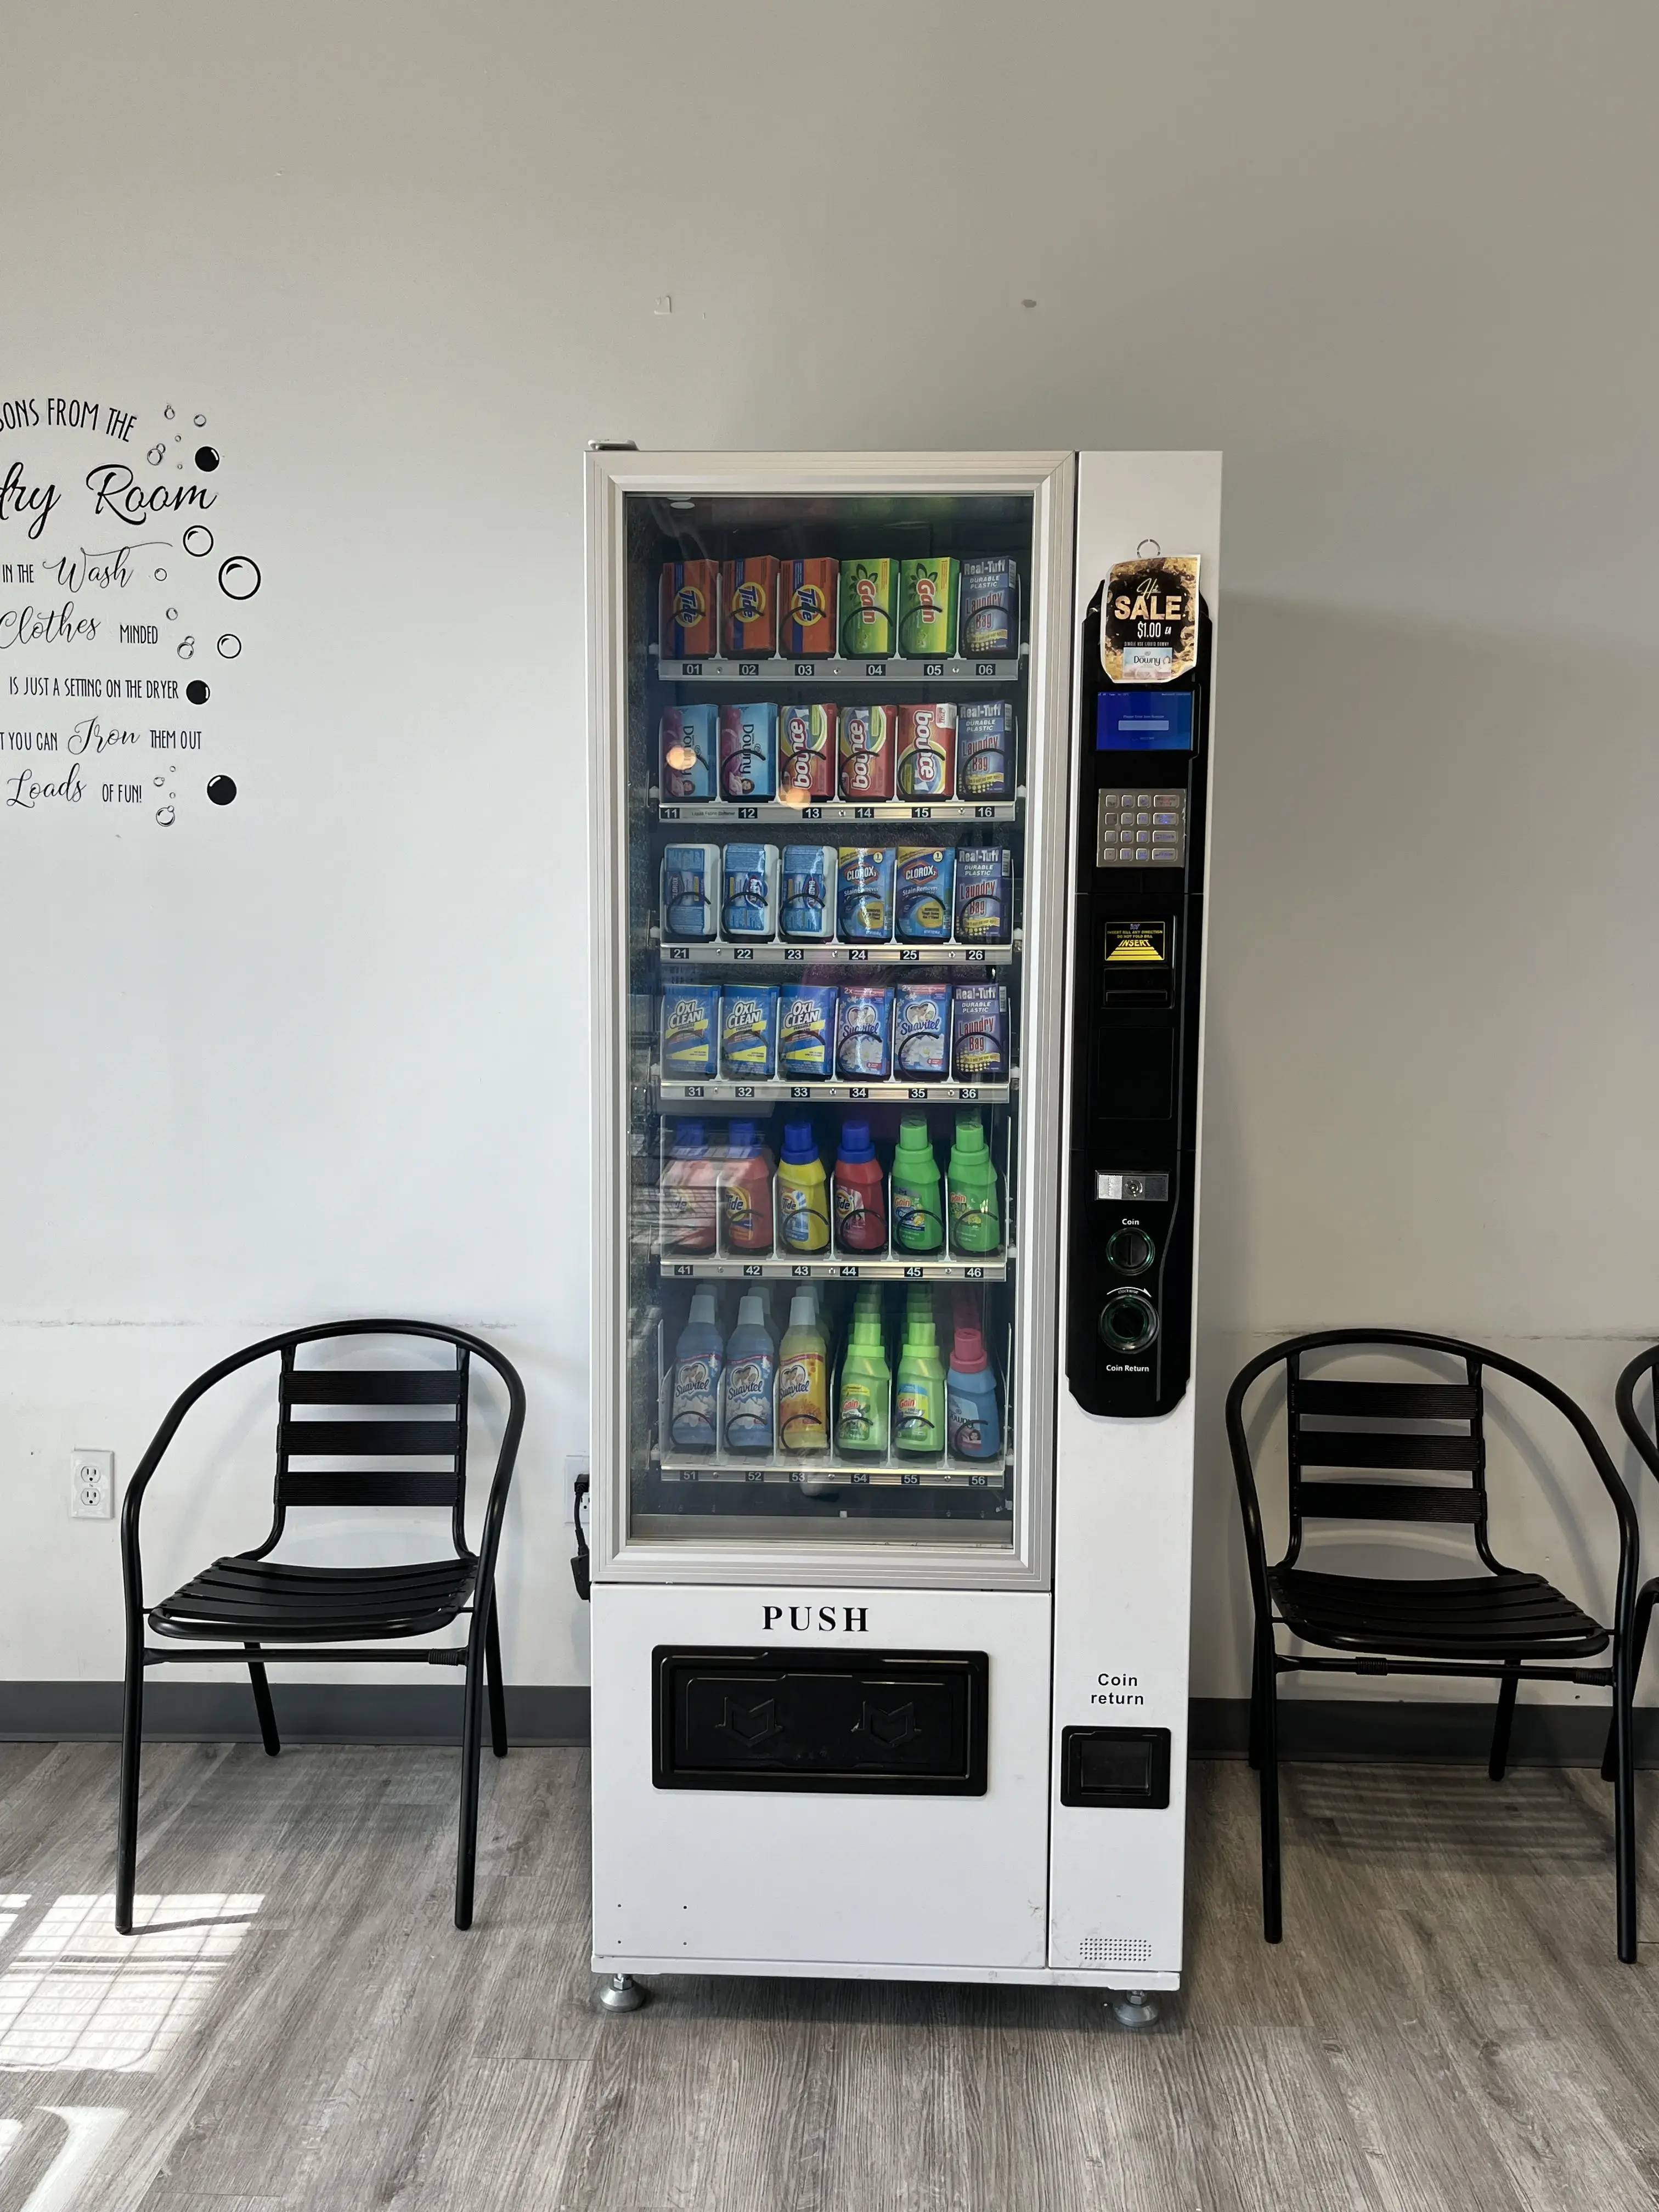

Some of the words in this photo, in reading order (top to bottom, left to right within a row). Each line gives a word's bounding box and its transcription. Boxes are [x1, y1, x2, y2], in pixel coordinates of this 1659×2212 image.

[47, 398, 99, 430] FROM
[106, 408, 137, 442] THE
[86, 464, 218, 525] Room
[2, 564, 13, 583] IN
[17, 564, 34, 583] THE
[43, 542, 173, 592] Wash
[738, 586, 757, 618] Tide
[966, 592, 1002, 614] Laundry
[1114, 596, 1182, 620] SALE
[0, 601, 101, 648] Clothes
[120, 624, 158, 644] MINDED
[975, 613, 992, 629] Bag
[1137, 621, 1161, 639] $1.00
[1165, 627, 1172, 635] EA
[1134, 656, 1160, 667] Downy
[687, 664, 699, 674] 01
[742, 665, 756, 675] 02
[798, 665, 812, 675] 03
[868, 665, 882, 675] 04
[927, 665, 941, 675] 05
[979, 665, 992, 675] 06
[9, 676, 18, 695] IS
[24, 677, 49, 696] JUST
[53, 678, 60, 696] A
[65, 679, 101, 697] SETTING
[106, 679, 121, 698] ON
[125, 680, 142, 698] THE
[146, 680, 178, 699] DRYER
[10, 732, 32, 750] YOU
[36, 732, 58, 751] CAN
[67, 715, 140, 755] Iron
[150, 730, 176, 749] THEM
[180, 731, 202, 749] OUT
[963, 735, 998, 757] Laundry
[972, 757, 988, 771] Bag
[6, 763, 87, 808] Loads
[102, 783, 114, 802] OF
[119, 784, 142, 803] FUN!
[665, 809, 678, 819] 11
[741, 809, 755, 819] 12
[805, 809, 819, 819] 13
[857, 809, 872, 818] 14
[915, 808, 929, 817] 15
[978, 808, 992, 817] 16
[960, 850, 998, 862] Real-Tuff
[844, 888, 859, 897] Stain
[902, 887, 916, 896] Stain
[961, 881, 995, 899] Laundry
[969, 901, 985, 915] Bag
[674, 949, 686, 959] 21
[737, 950, 751, 959] 22
[787, 950, 802, 960] 23
[852, 950, 866, 960] 24
[903, 950, 917, 960] 25
[968, 950, 983, 960] 26
[956, 987, 996, 999] Real-Tuff
[676, 1001, 696, 1015] OXI
[735, 1002, 755, 1016] OXI
[792, 1001, 812, 1015] OXI
[669, 1009, 702, 1029] CLEAN
[727, 1011, 761, 1029] CLEAN
[785, 1009, 820, 1029] CLEAN
[901, 1019, 940, 1035] Suavitel
[960, 1017, 993, 1035] Laundry
[969, 1037, 984, 1051] Bag
[689, 1087, 701, 1096] 31
[738, 1087, 752, 1097] 32
[794, 1087, 808, 1097] 33
[852, 1088, 866, 1097] 34
[911, 1088, 926, 1098] 35
[962, 1089, 976, 1098] 36
[726, 1194, 743, 1210] Tide
[782, 1198, 796, 1210] Tide
[895, 1197, 911, 1207] Gain
[678, 1266, 691, 1275] 41
[746, 1266, 760, 1275] 42
[794, 1266, 809, 1276] 43
[842, 1267, 856, 1276] 44
[906, 1267, 921, 1277] 45
[967, 1268, 981, 1277] 46
[675, 1379, 709, 1397] Suavitel
[728, 1381, 763, 1400] Suavitel
[780, 1380, 809, 1400] Suavitel
[843, 1400, 859, 1410] Gain
[899, 1399, 915, 1408] Gain
[684, 1471, 696, 1480] 51
[748, 1472, 761, 1481] 52
[792, 1472, 805, 1482] 53
[854, 1474, 867, 1483] 54
[904, 1475, 918, 1483] 55
[971, 1476, 985, 1485] 56
[762, 1606, 869, 1632] PUSH
[1098, 1673, 1138, 1686] Coin
[1091, 1692, 1144, 1705] return
